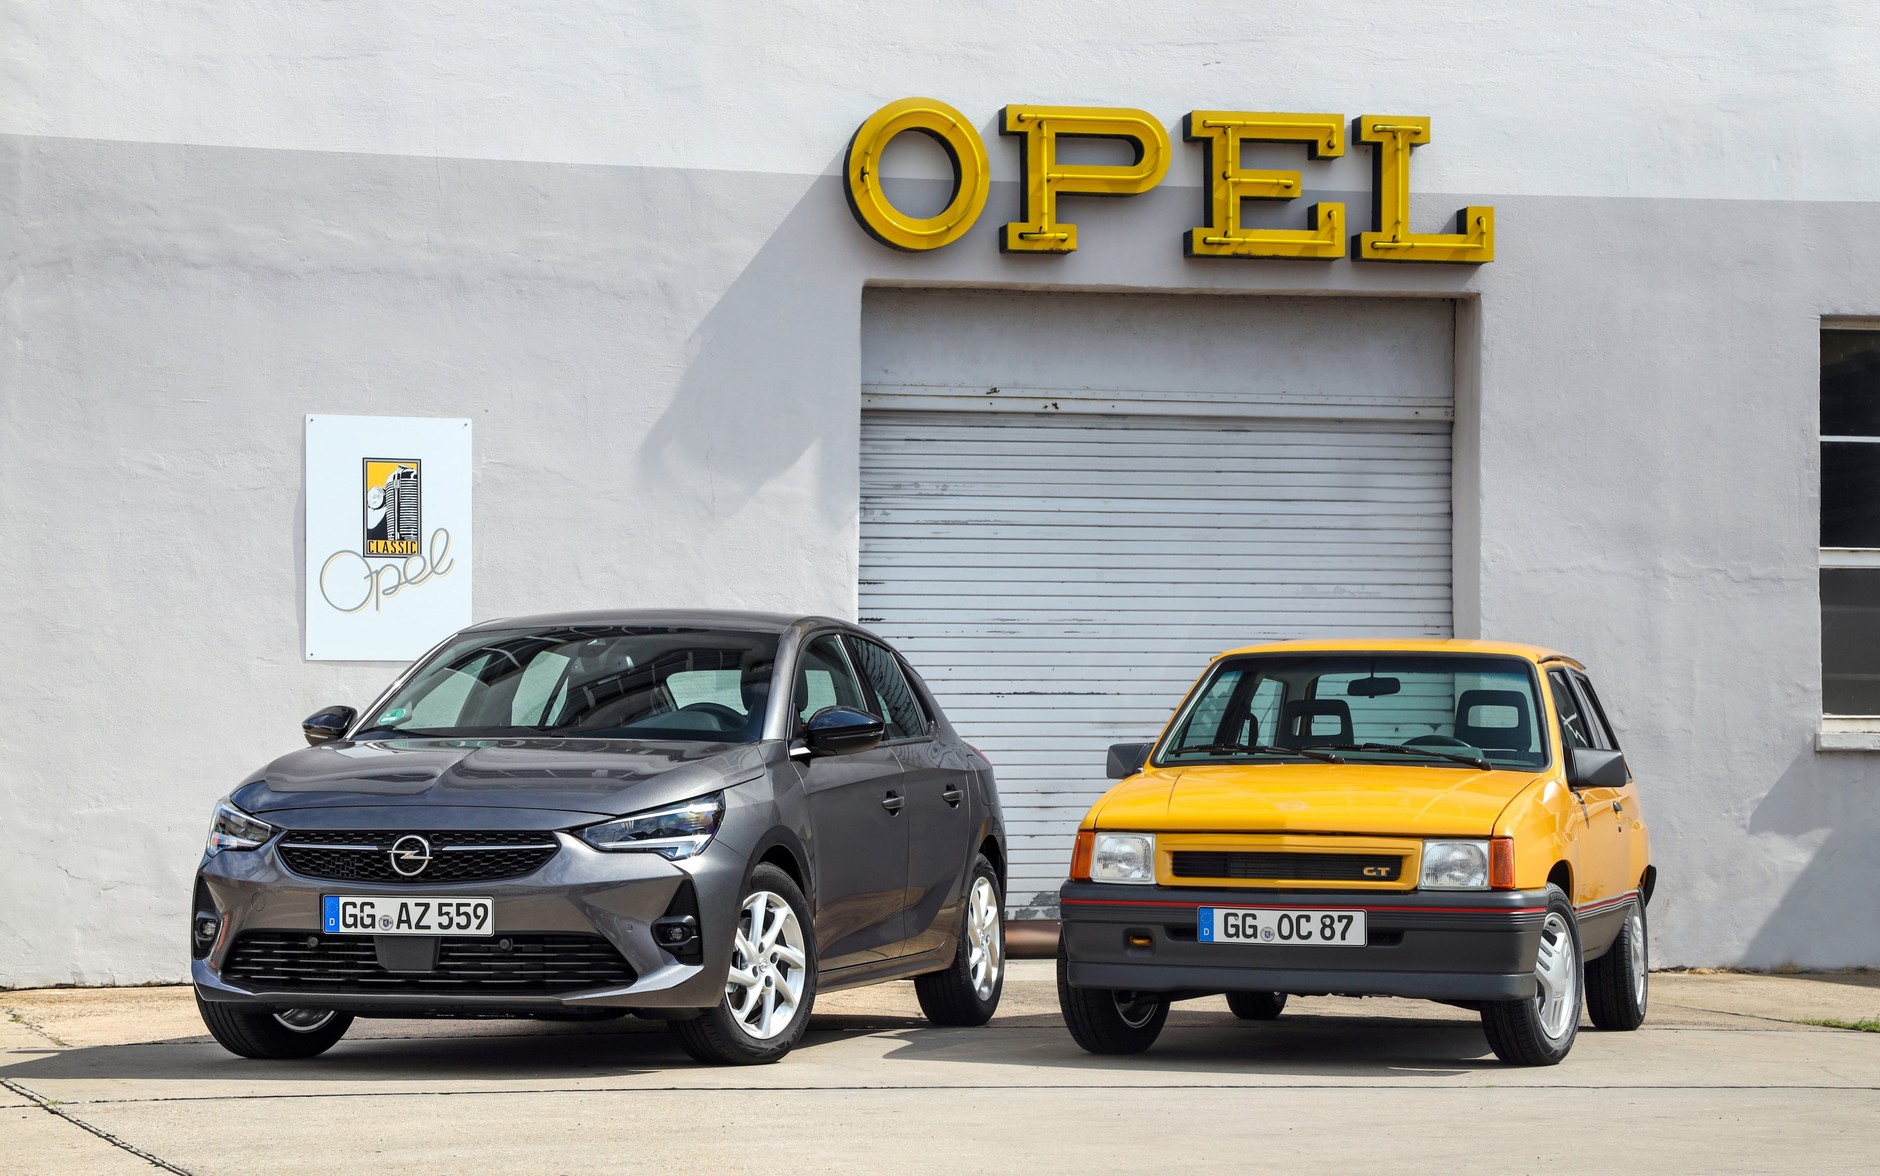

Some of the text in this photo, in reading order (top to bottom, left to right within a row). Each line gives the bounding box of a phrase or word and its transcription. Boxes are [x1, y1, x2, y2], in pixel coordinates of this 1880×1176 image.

[843, 97, 1495, 263] OPEL
[367, 540, 418, 554] CLASSIC
[319, 528, 454, 613] Opel
[1362, 866, 1391, 877] GT
[329, 901, 489, 930] D GG AZ 559
[1203, 912, 1354, 941] D GG OC 87
